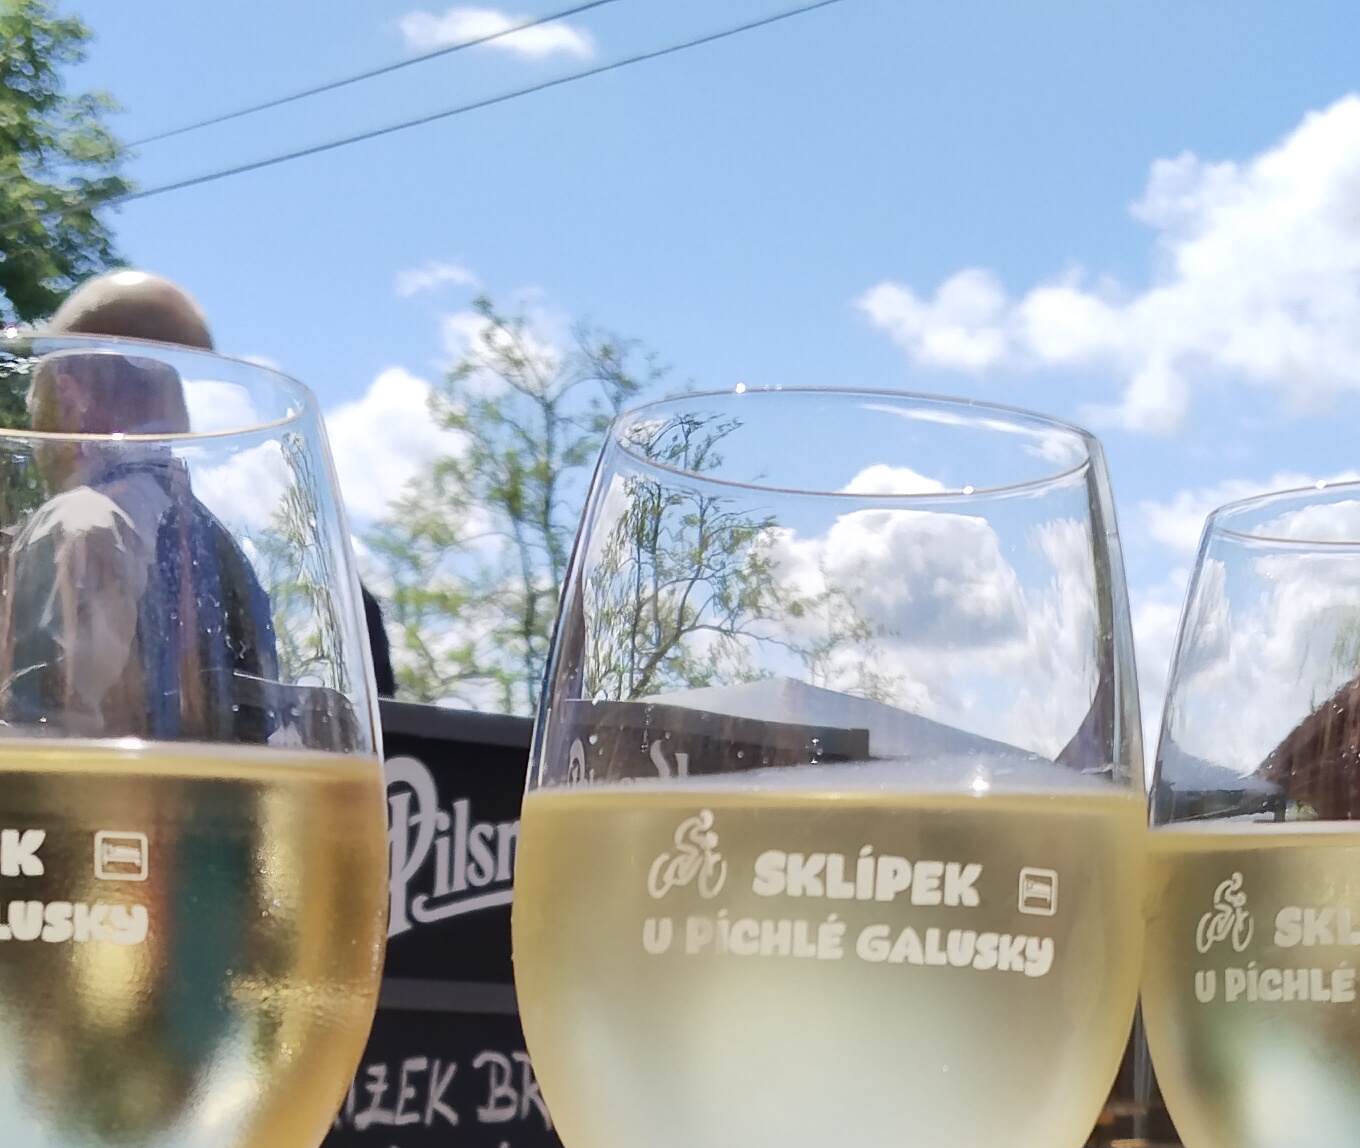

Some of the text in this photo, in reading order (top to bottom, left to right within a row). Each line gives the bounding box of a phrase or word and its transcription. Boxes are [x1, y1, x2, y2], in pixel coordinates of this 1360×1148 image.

[752, 844, 983, 907] SKLÍPEK
[642, 908, 1056, 978] U PÍCHLÉ GALUSKY
[1194, 969, 1217, 1004] U
[1224, 960, 1357, 1004] PÍCHLÉ
